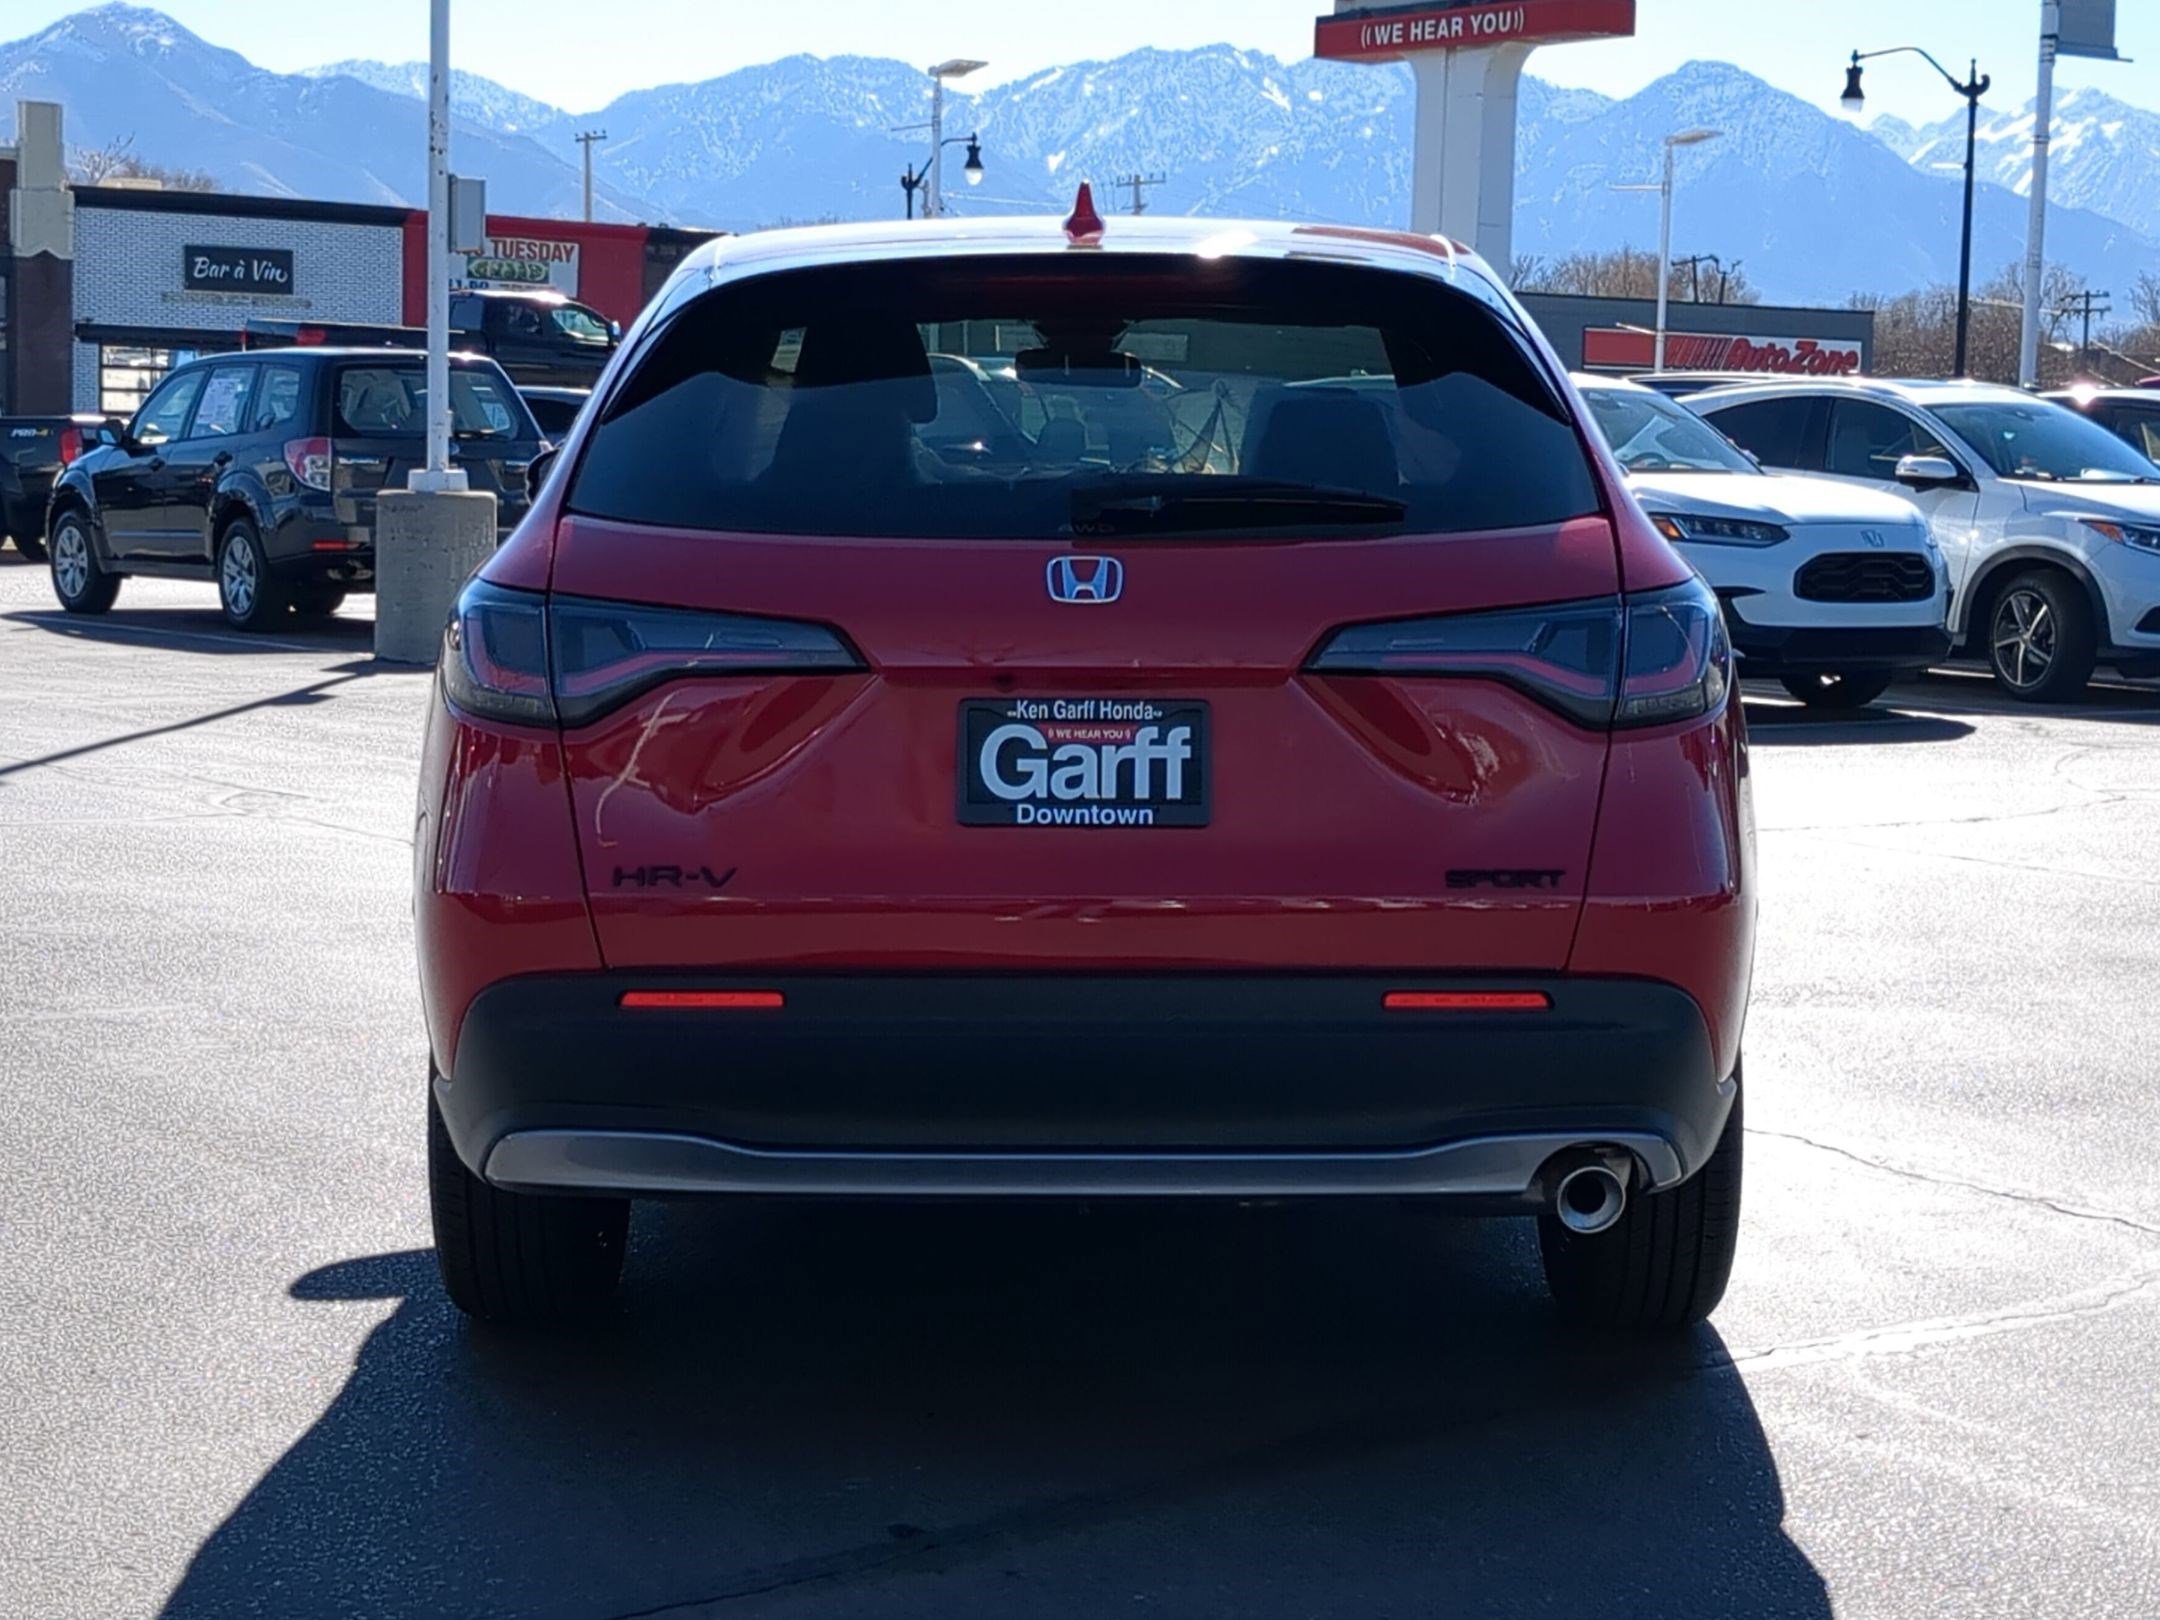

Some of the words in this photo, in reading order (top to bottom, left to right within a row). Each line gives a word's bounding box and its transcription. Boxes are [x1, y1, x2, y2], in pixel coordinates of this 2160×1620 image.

[1410, 17, 1463, 42] HEAR
[490, 238, 576, 263] TUESDAY
[193, 256, 230, 279] Bar
[253, 259, 289, 283] Vin
[1725, 337, 1859, 375] AutoZone
[1016, 699, 1049, 720] Ken
[1053, 699, 1094, 720] Garff
[1100, 699, 1154, 720] Honda
[1074, 728, 1101, 739] HEAR
[980, 723, 1192, 801] Garff
[1016, 803, 1154, 825] Downtown
[613, 865, 738, 888] HR-V
[1445, 869, 1567, 889] SPORT
